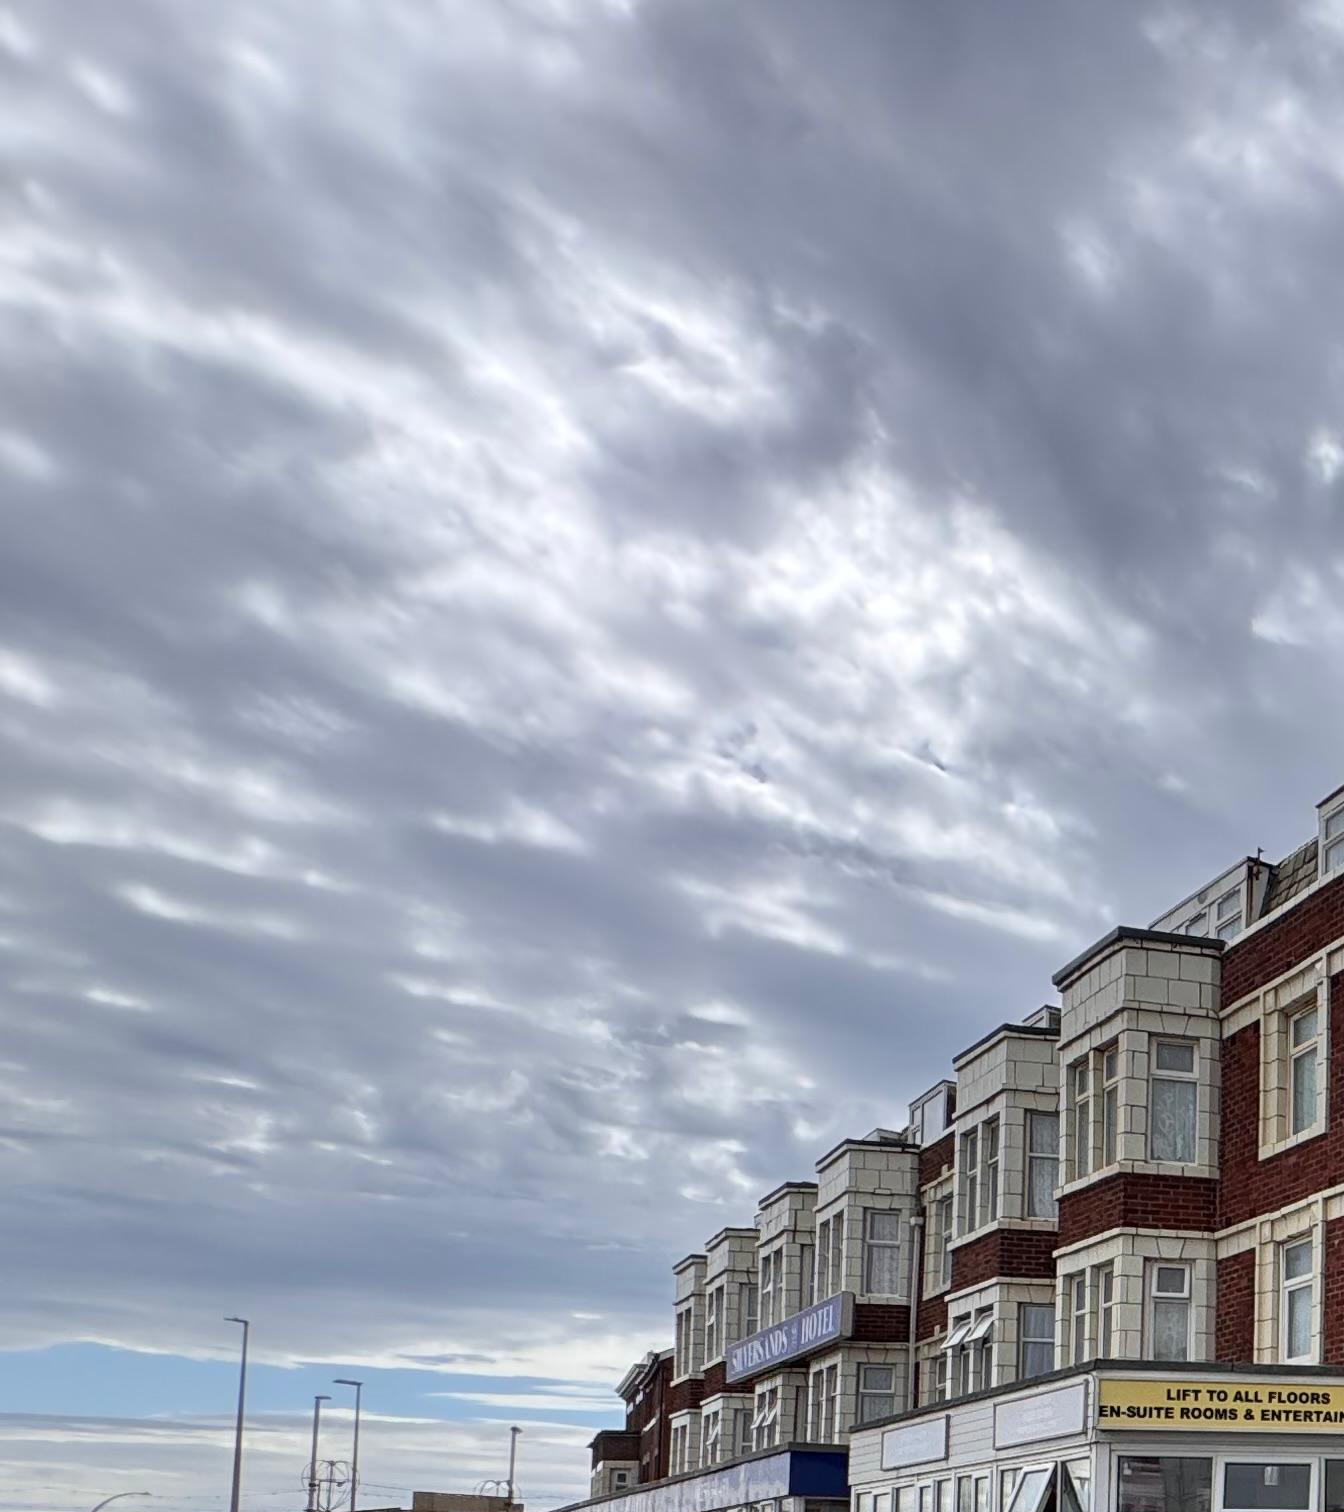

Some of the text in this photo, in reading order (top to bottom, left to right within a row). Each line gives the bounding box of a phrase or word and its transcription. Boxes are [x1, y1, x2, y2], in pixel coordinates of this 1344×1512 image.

[801, 1304, 834, 1344] HOTEL
[1167, 1388, 1331, 1405] LIFT TO ALL FLOORS
[1099, 1405, 1174, 1419] EN-SUITE
[1180, 1407, 1238, 1421] ROOMS
[1243, 1408, 1255, 1421] &
